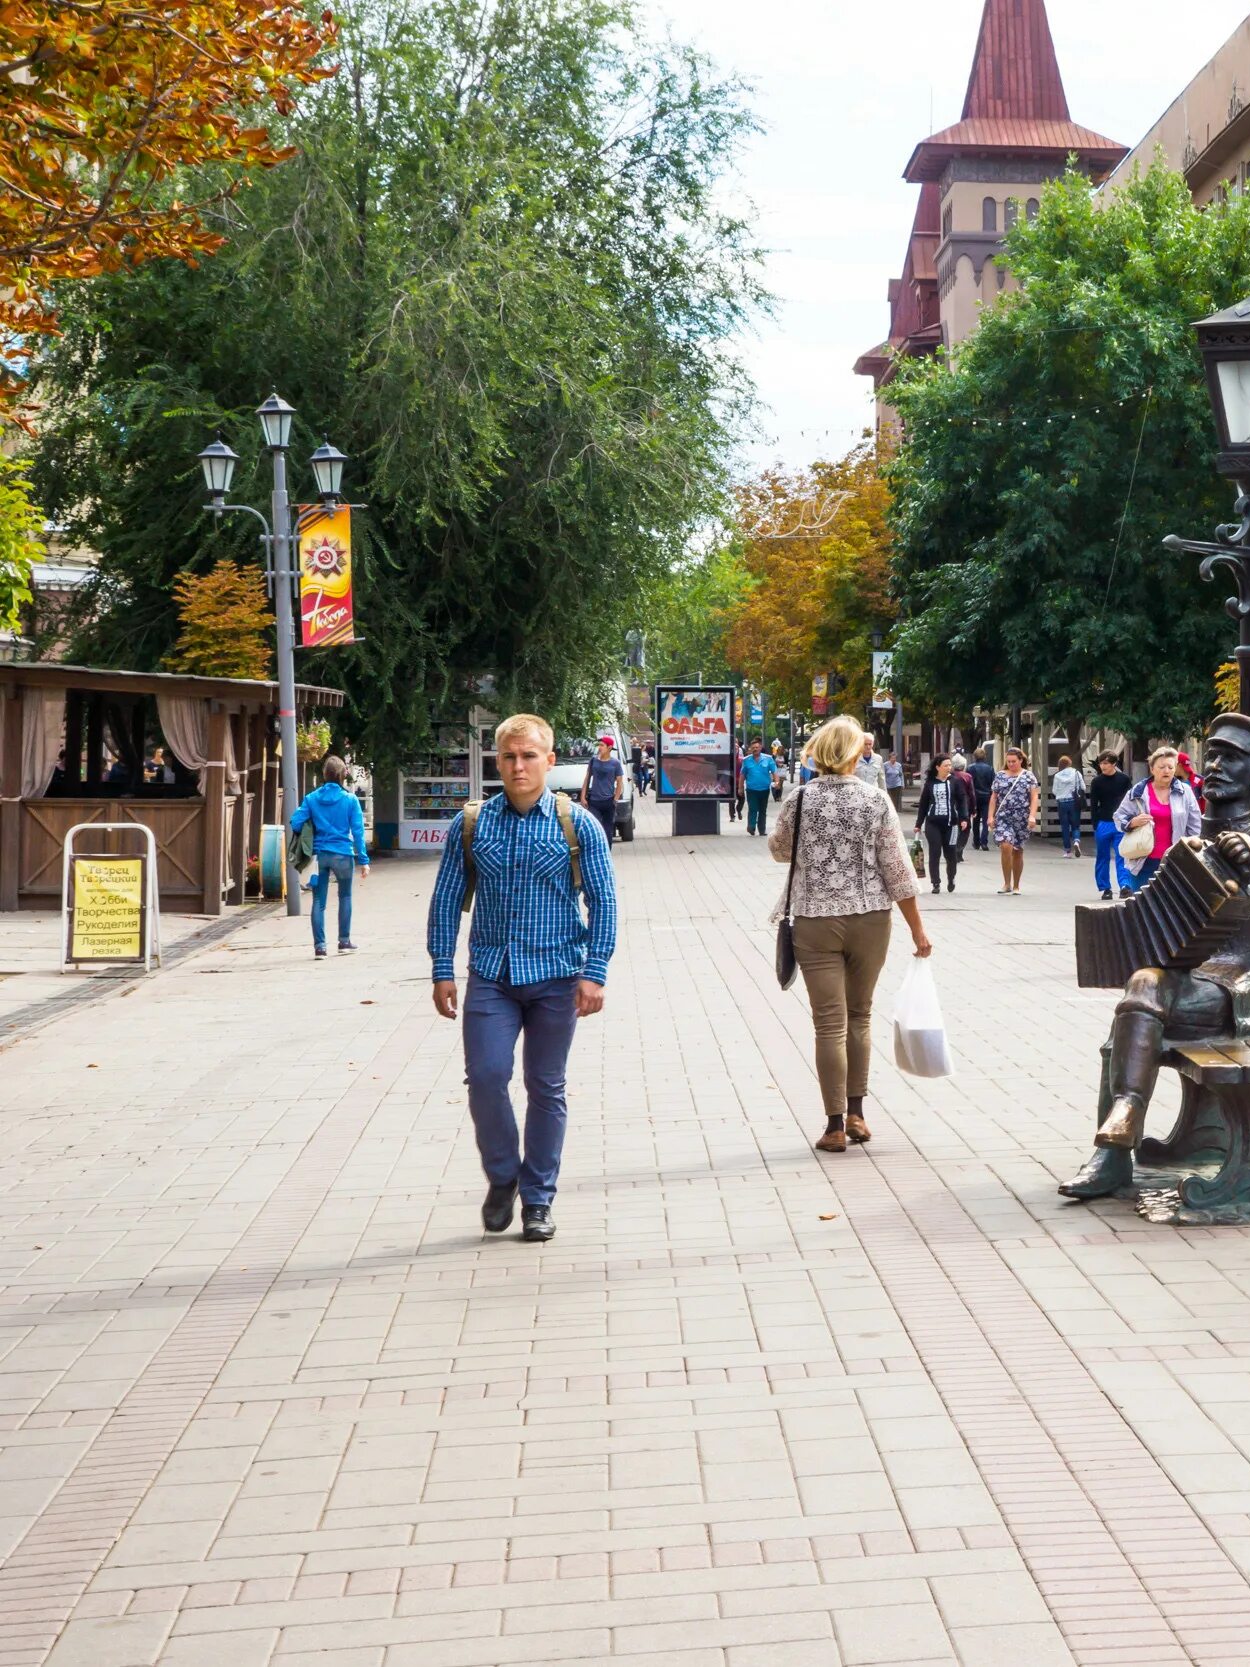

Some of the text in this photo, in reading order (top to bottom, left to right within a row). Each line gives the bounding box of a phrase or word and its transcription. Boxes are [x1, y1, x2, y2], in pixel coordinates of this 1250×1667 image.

[663, 717, 728, 735] ОЛЬГА
[411, 829, 448, 843] ТАБА
[76, 907, 141, 917] Творчества
[77, 920, 138, 932] Рукоделия
[81, 937, 132, 946] Лазерная
[92, 947, 121, 955] резка
